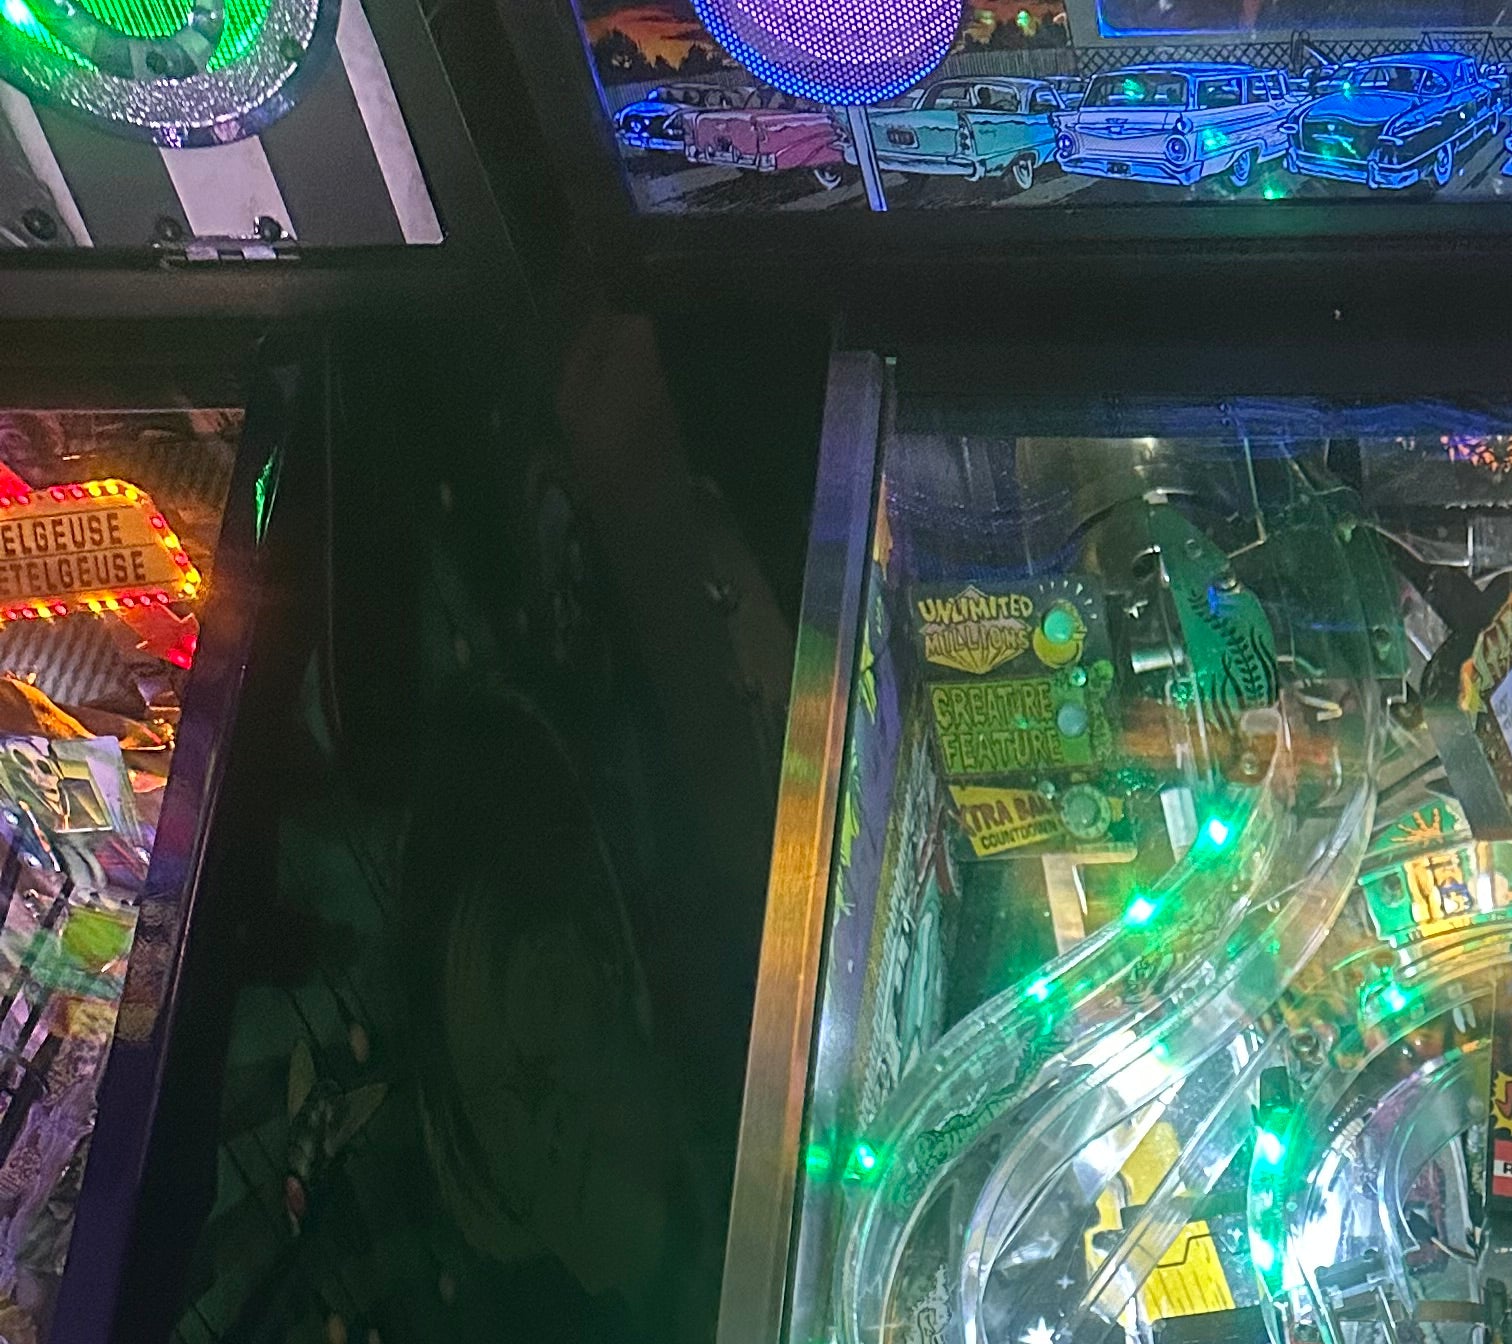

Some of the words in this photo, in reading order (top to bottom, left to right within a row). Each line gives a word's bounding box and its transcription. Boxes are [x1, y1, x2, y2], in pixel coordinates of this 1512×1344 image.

[917, 594, 1034, 624] UNLIMITED
[924, 626, 1031, 656] MILLIONS
[932, 683, 1053, 732] CREATURE
[942, 728, 1065, 771] FEATURE
